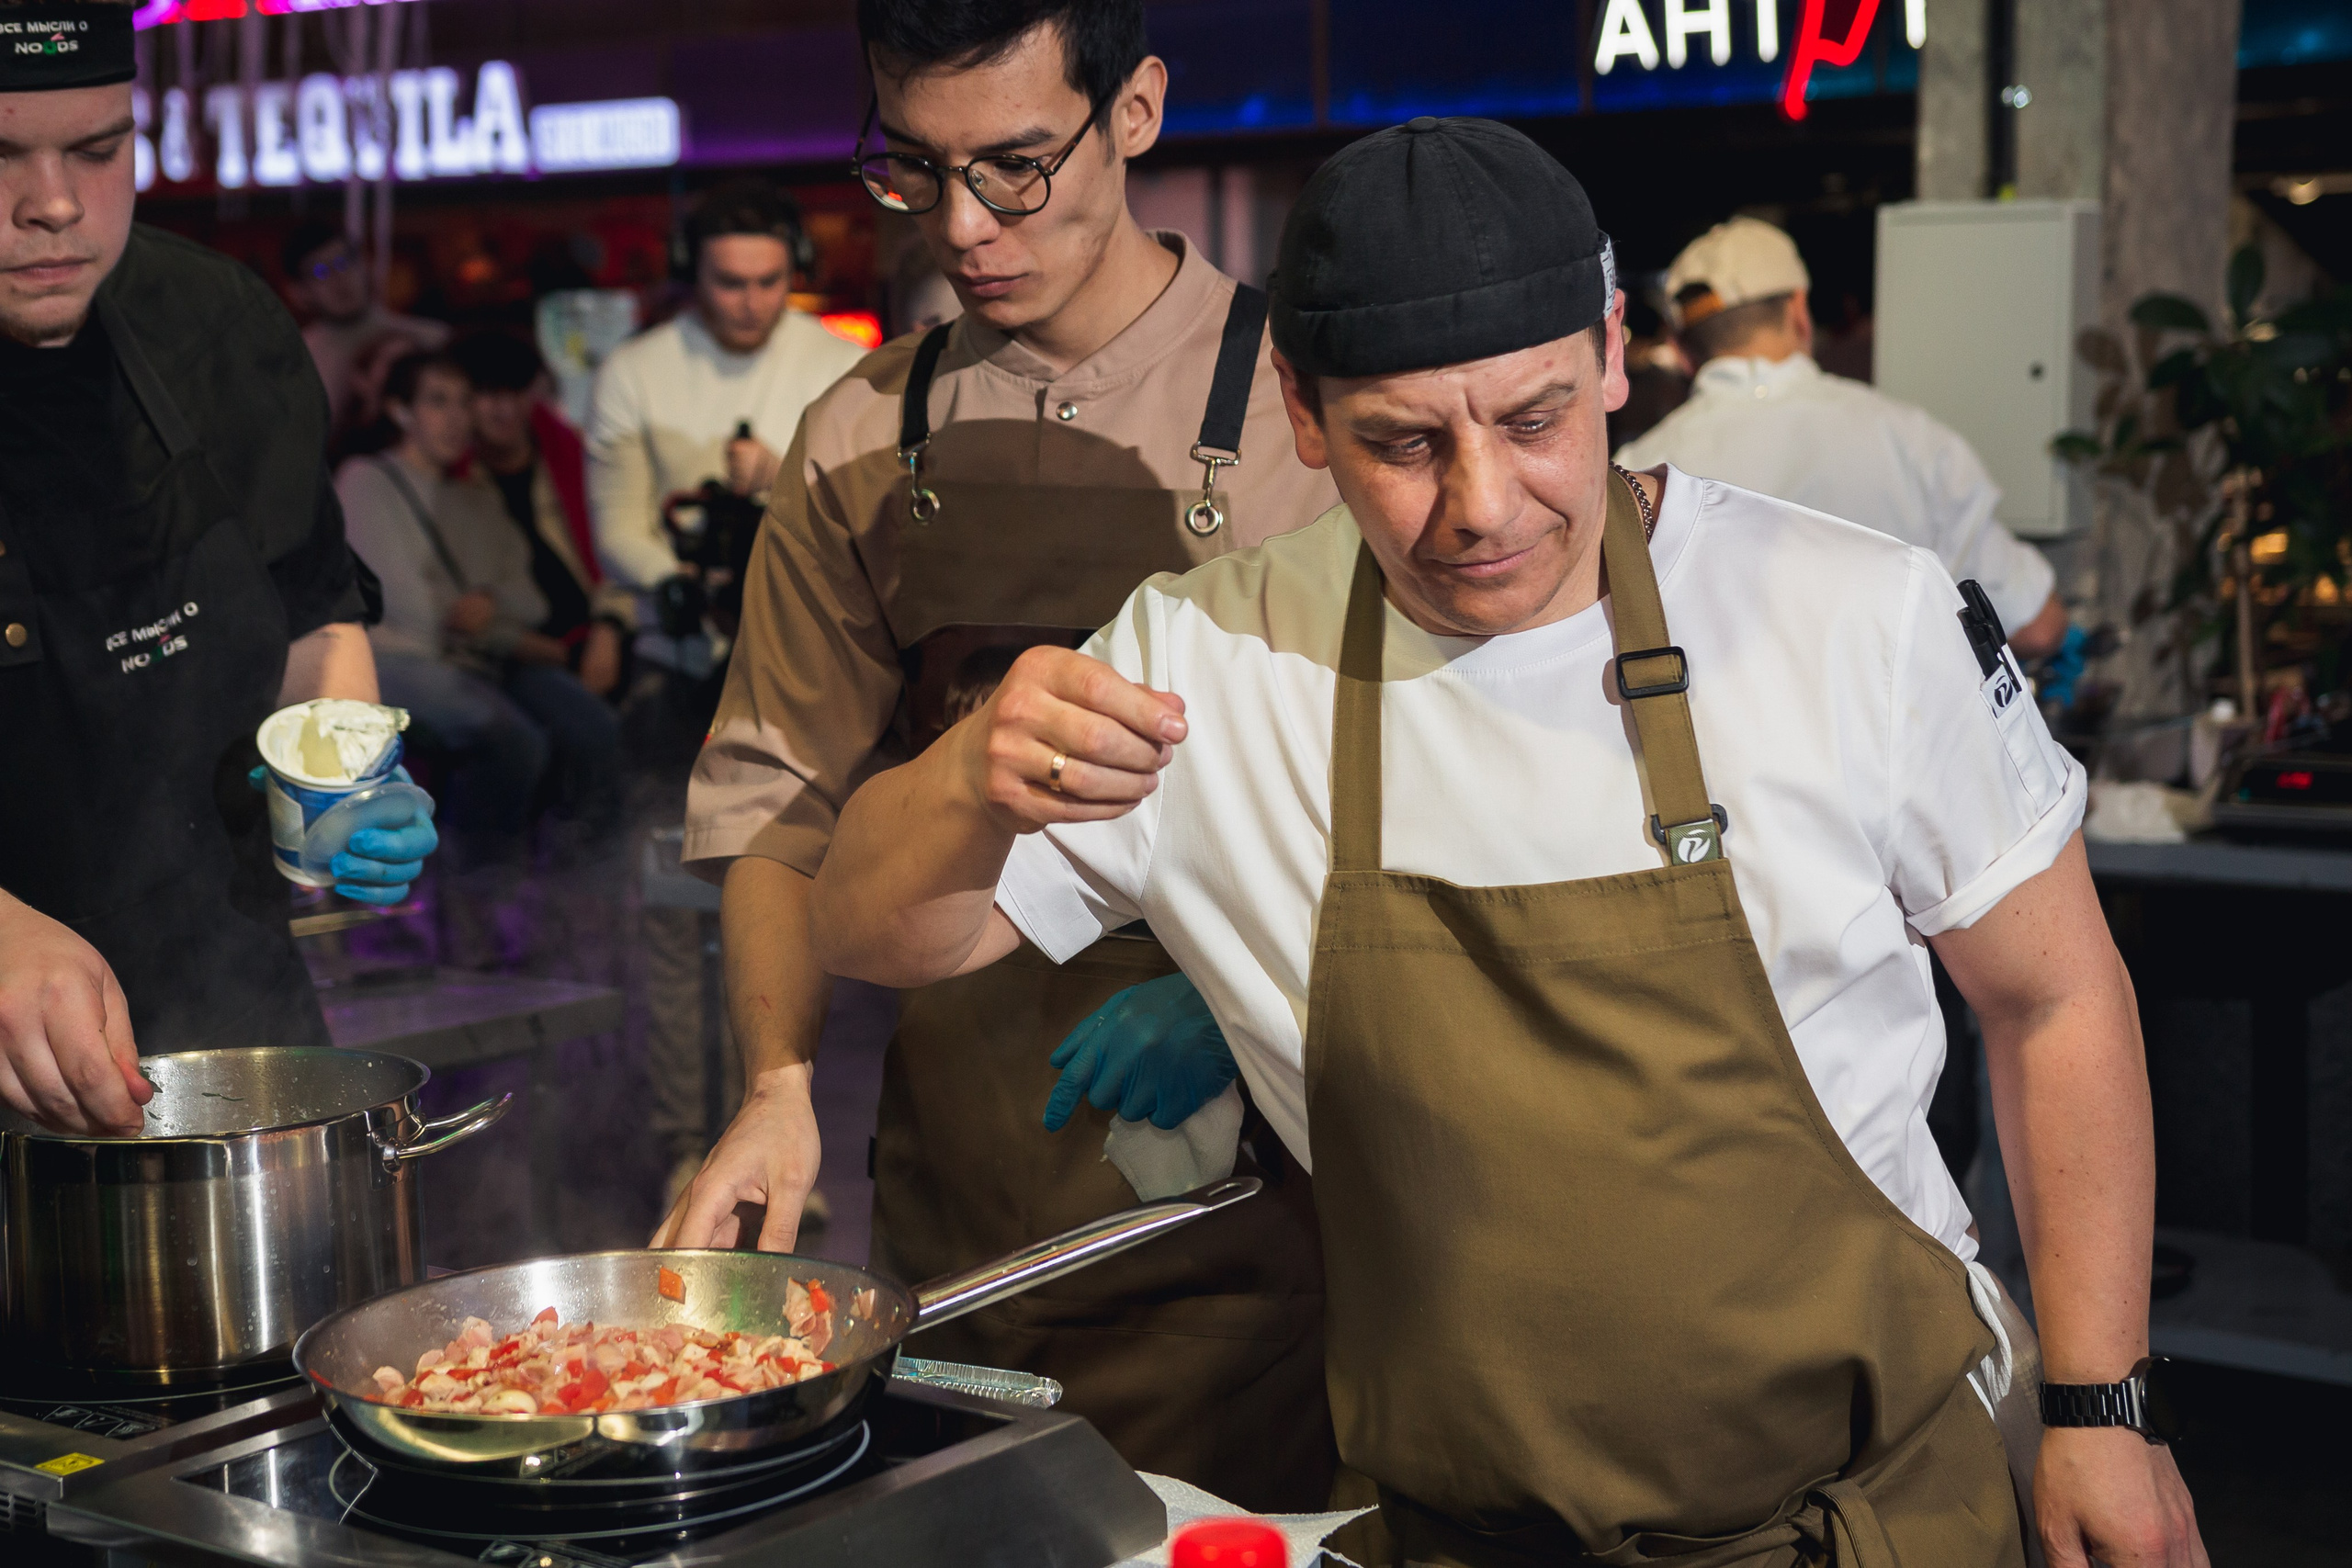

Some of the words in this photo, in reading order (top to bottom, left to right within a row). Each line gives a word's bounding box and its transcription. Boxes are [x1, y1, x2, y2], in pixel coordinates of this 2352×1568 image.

[27, 20, 75, 33] МЫСЛИ
[15, 39, 80, 55] NOODS
[121, 635, 187, 674] NOODS
